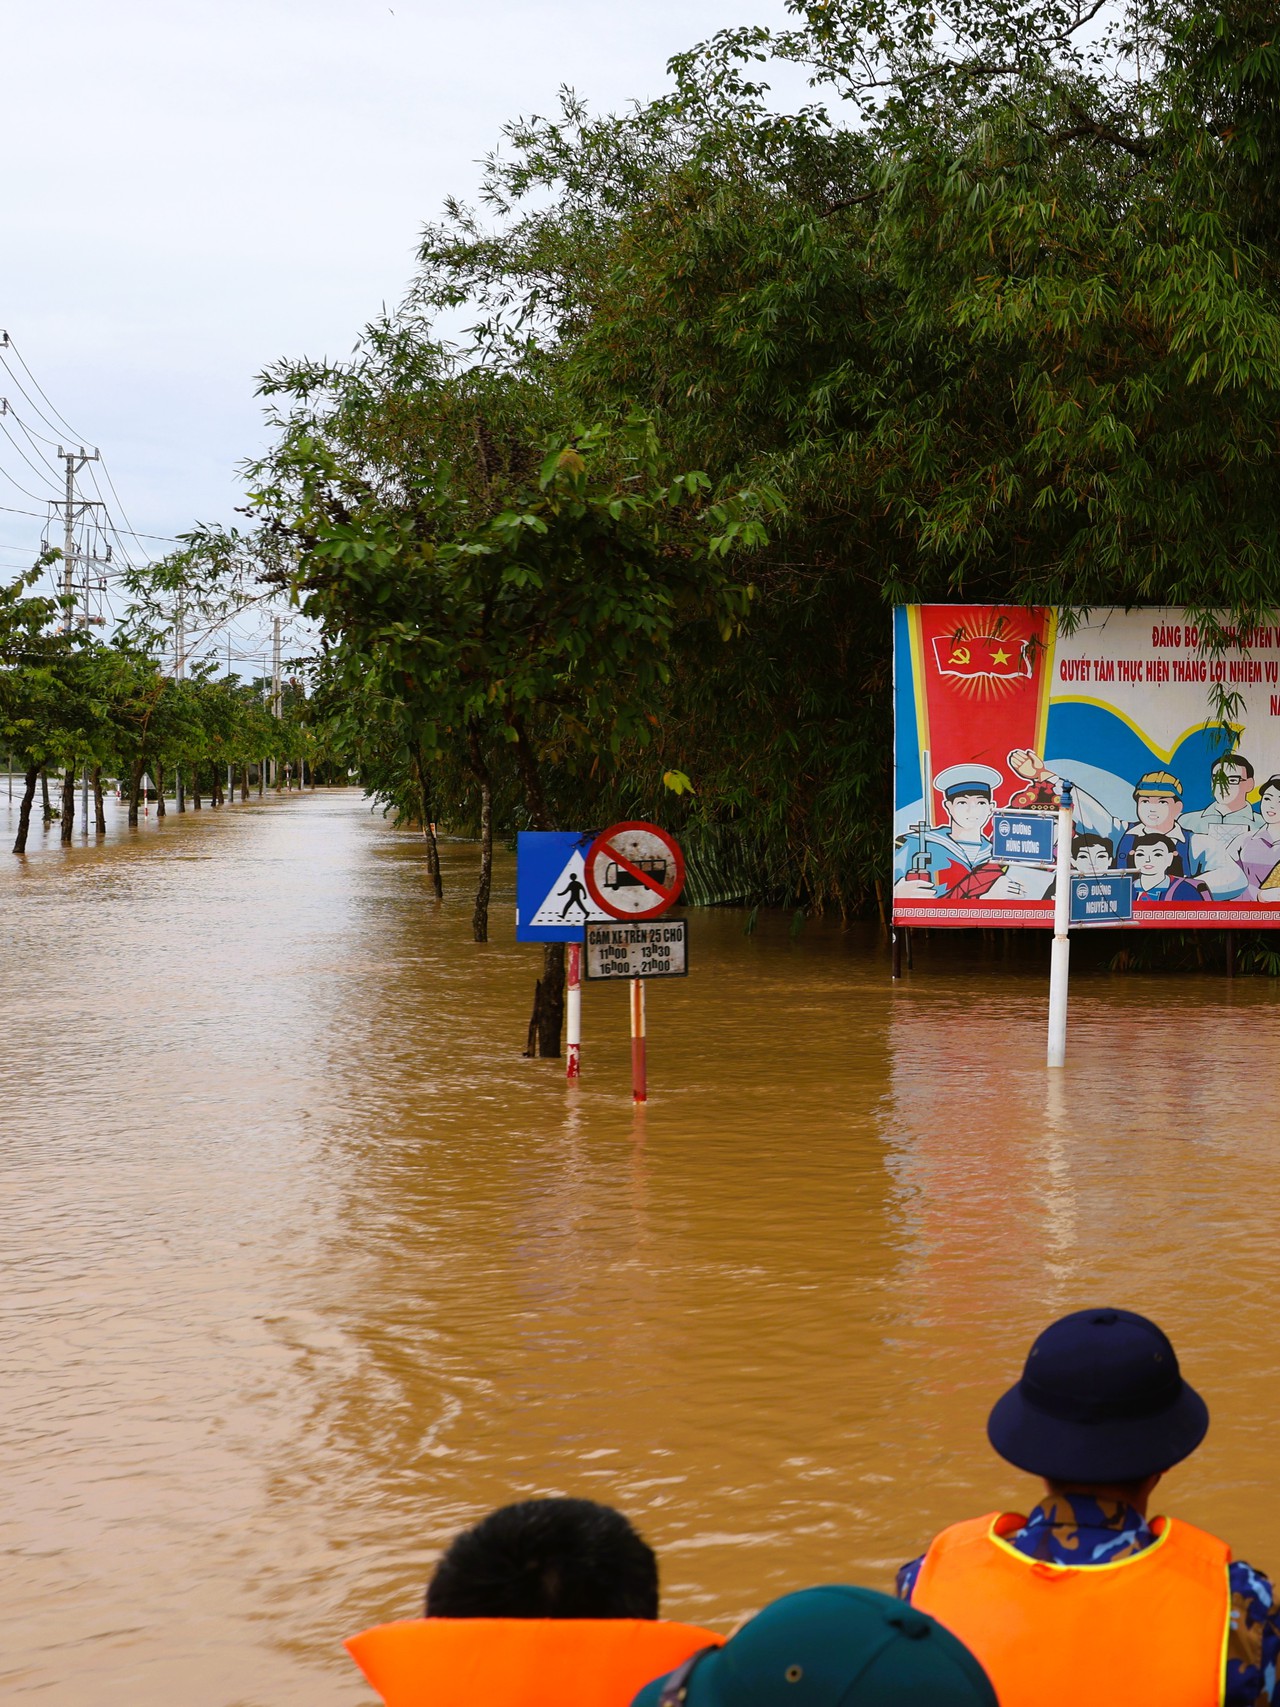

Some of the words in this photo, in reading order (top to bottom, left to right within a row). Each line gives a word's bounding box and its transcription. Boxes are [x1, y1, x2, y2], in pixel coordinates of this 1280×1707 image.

[1152, 620, 1181, 648] ĐẢNG
[1205, 622, 1236, 648] CNH
[1060, 653, 1091, 682] QUYẾT
[1094, 656, 1115, 682] TÂM
[1118, 660, 1143, 688] THỰC
[1146, 656, 1169, 688] HIỆN
[1172, 652, 1207, 682] THẮNG
[1230, 657, 1262, 688] NHIỆM
[1265, 661, 1278, 688] VỤ
[612, 930, 622, 943] XE
[650, 929, 661, 943] 25
[599, 945, 627, 959] 11h00
[641, 943, 670, 958] 13h30
[600, 960, 630, 974] 16h00
[641, 958, 670, 972] 21h00
